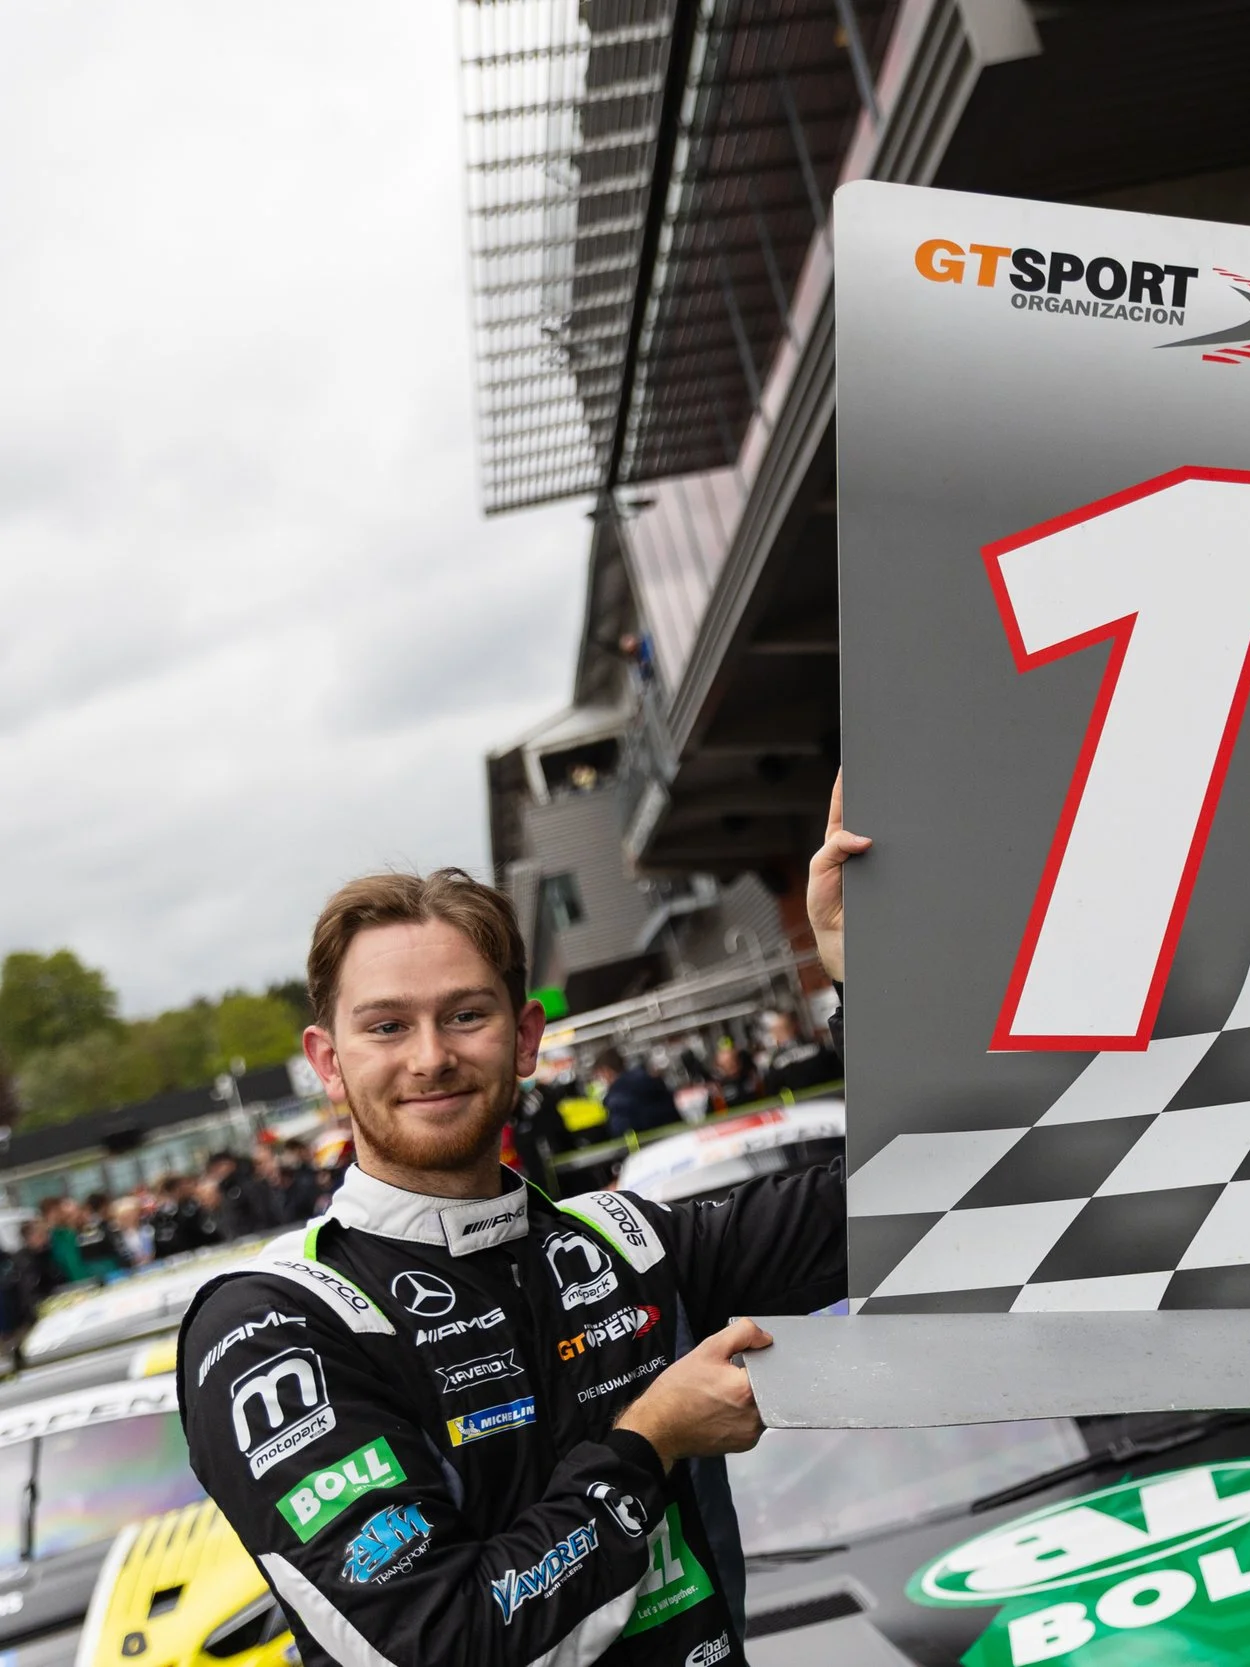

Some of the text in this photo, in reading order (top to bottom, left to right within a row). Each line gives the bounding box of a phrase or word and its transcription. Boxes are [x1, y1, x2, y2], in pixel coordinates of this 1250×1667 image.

[1011, 293, 1185, 327] ORGANIZACION
[590, 1193, 647, 1248] sparco
[274, 1260, 370, 1314] sparco
[436, 1307, 506, 1342] AMG
[256, 1415, 328, 1468] motopark
[480, 1405, 535, 1430] MICHELIN
[289, 1447, 391, 1526] BOLL
[371, 1538, 432, 1585] TRANSPORT
